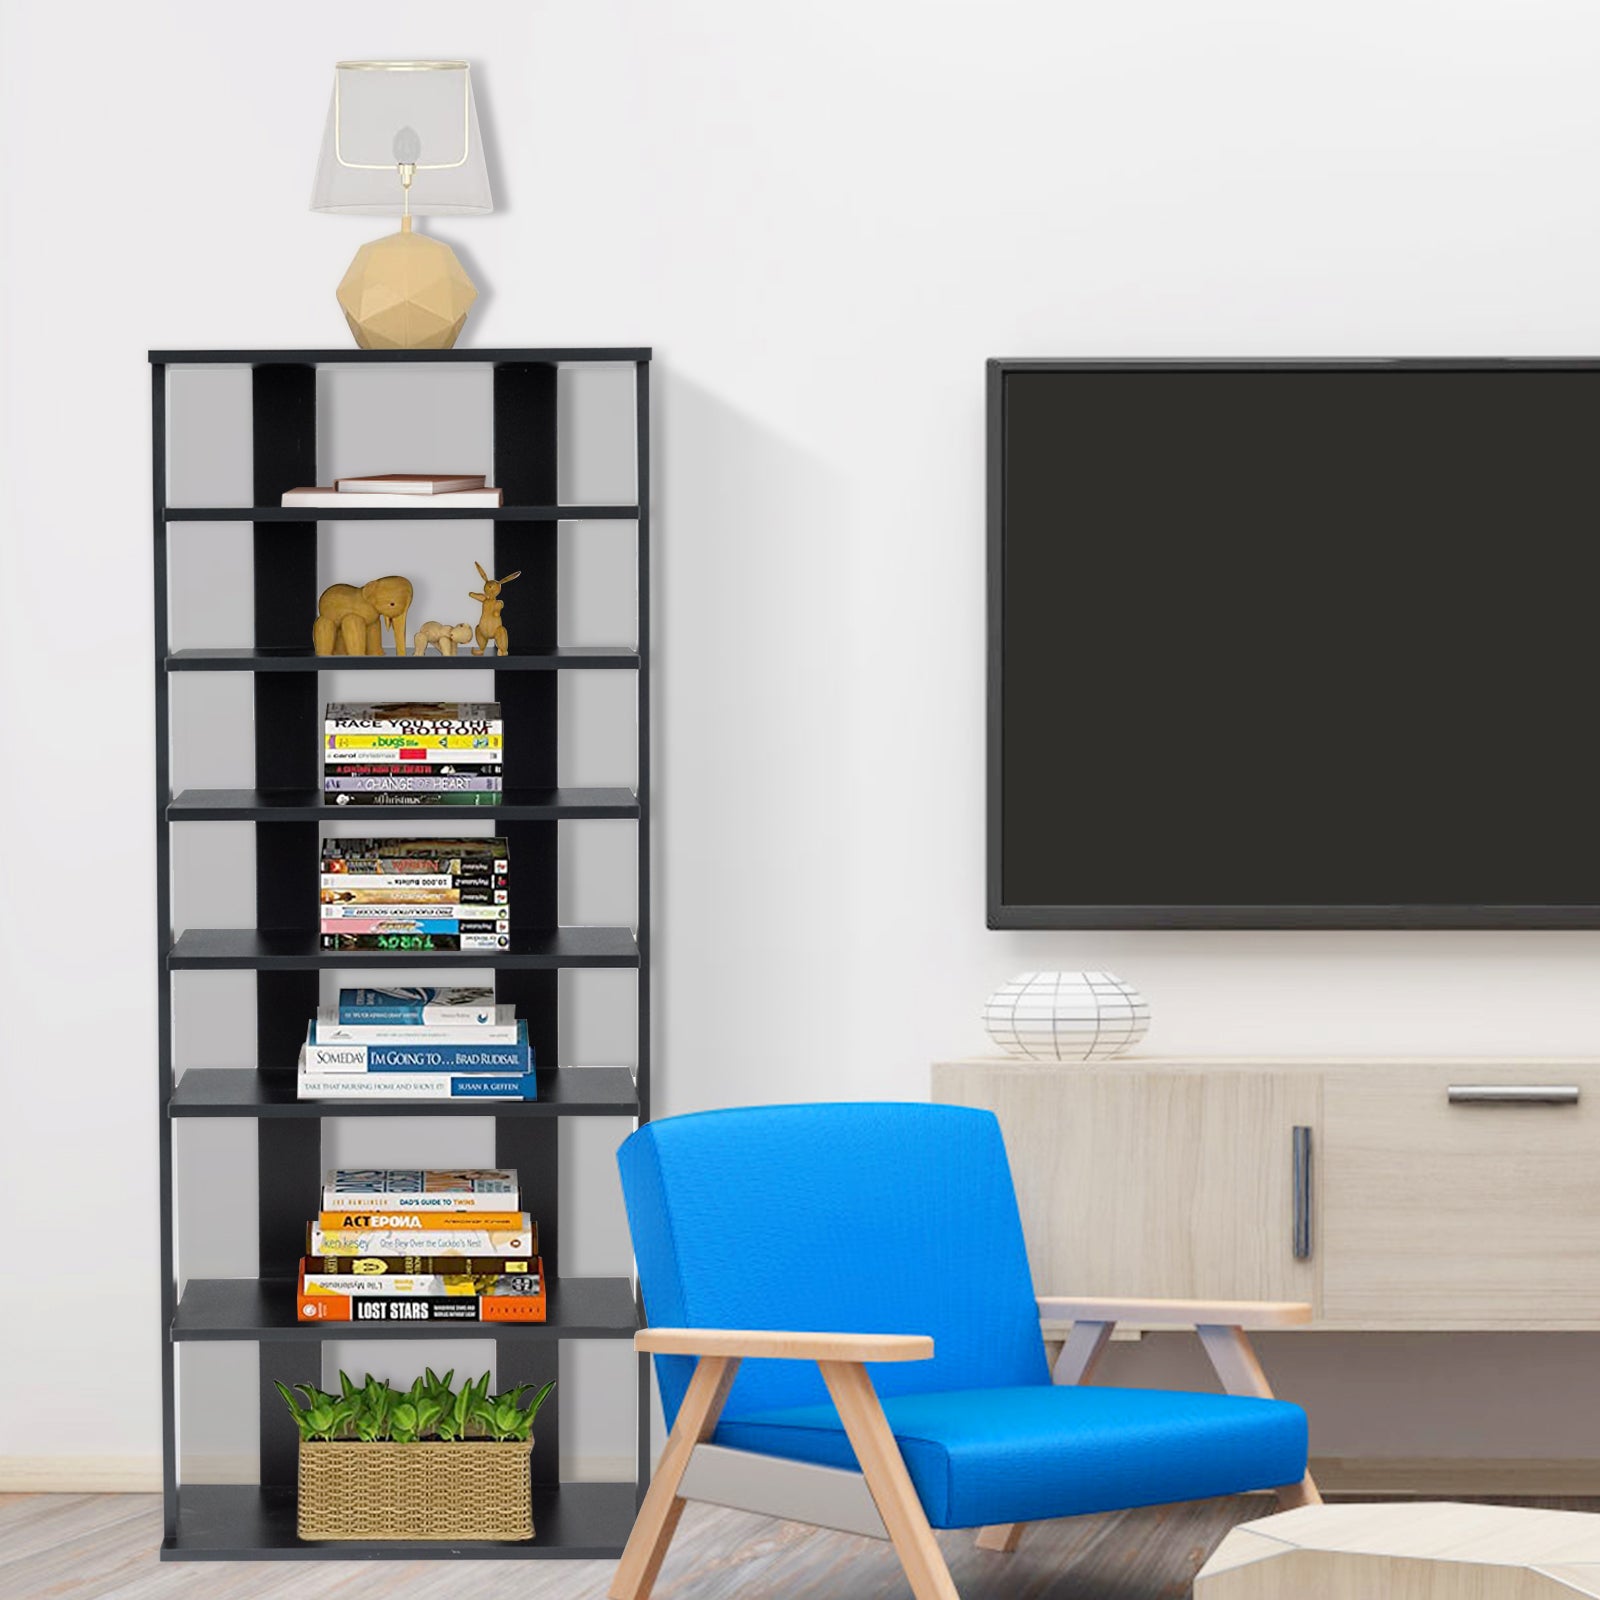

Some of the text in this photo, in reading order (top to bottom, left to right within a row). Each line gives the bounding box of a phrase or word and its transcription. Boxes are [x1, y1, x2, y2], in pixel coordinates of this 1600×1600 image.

[335, 720, 493, 728] RACE YOU TO THE
[402, 727, 489, 735] BOTTOM
[366, 778, 413, 791] CHANGE
[434, 778, 472, 791] HEART
[317, 1051, 365, 1064] SOMEDAY
[370, 1051, 386, 1064] I'M
[386, 1051, 425, 1064] GOING
[456, 1053, 519, 1064] BRAD RUDISAIL
[344, 1237, 369, 1251] kesey
[380, 1239, 394, 1248] One
[410, 1239, 425, 1248] Over
[426, 1239, 437, 1248] the
[467, 1239, 482, 1248] Nest
[358, 1302, 429, 1319] LOST STARS
